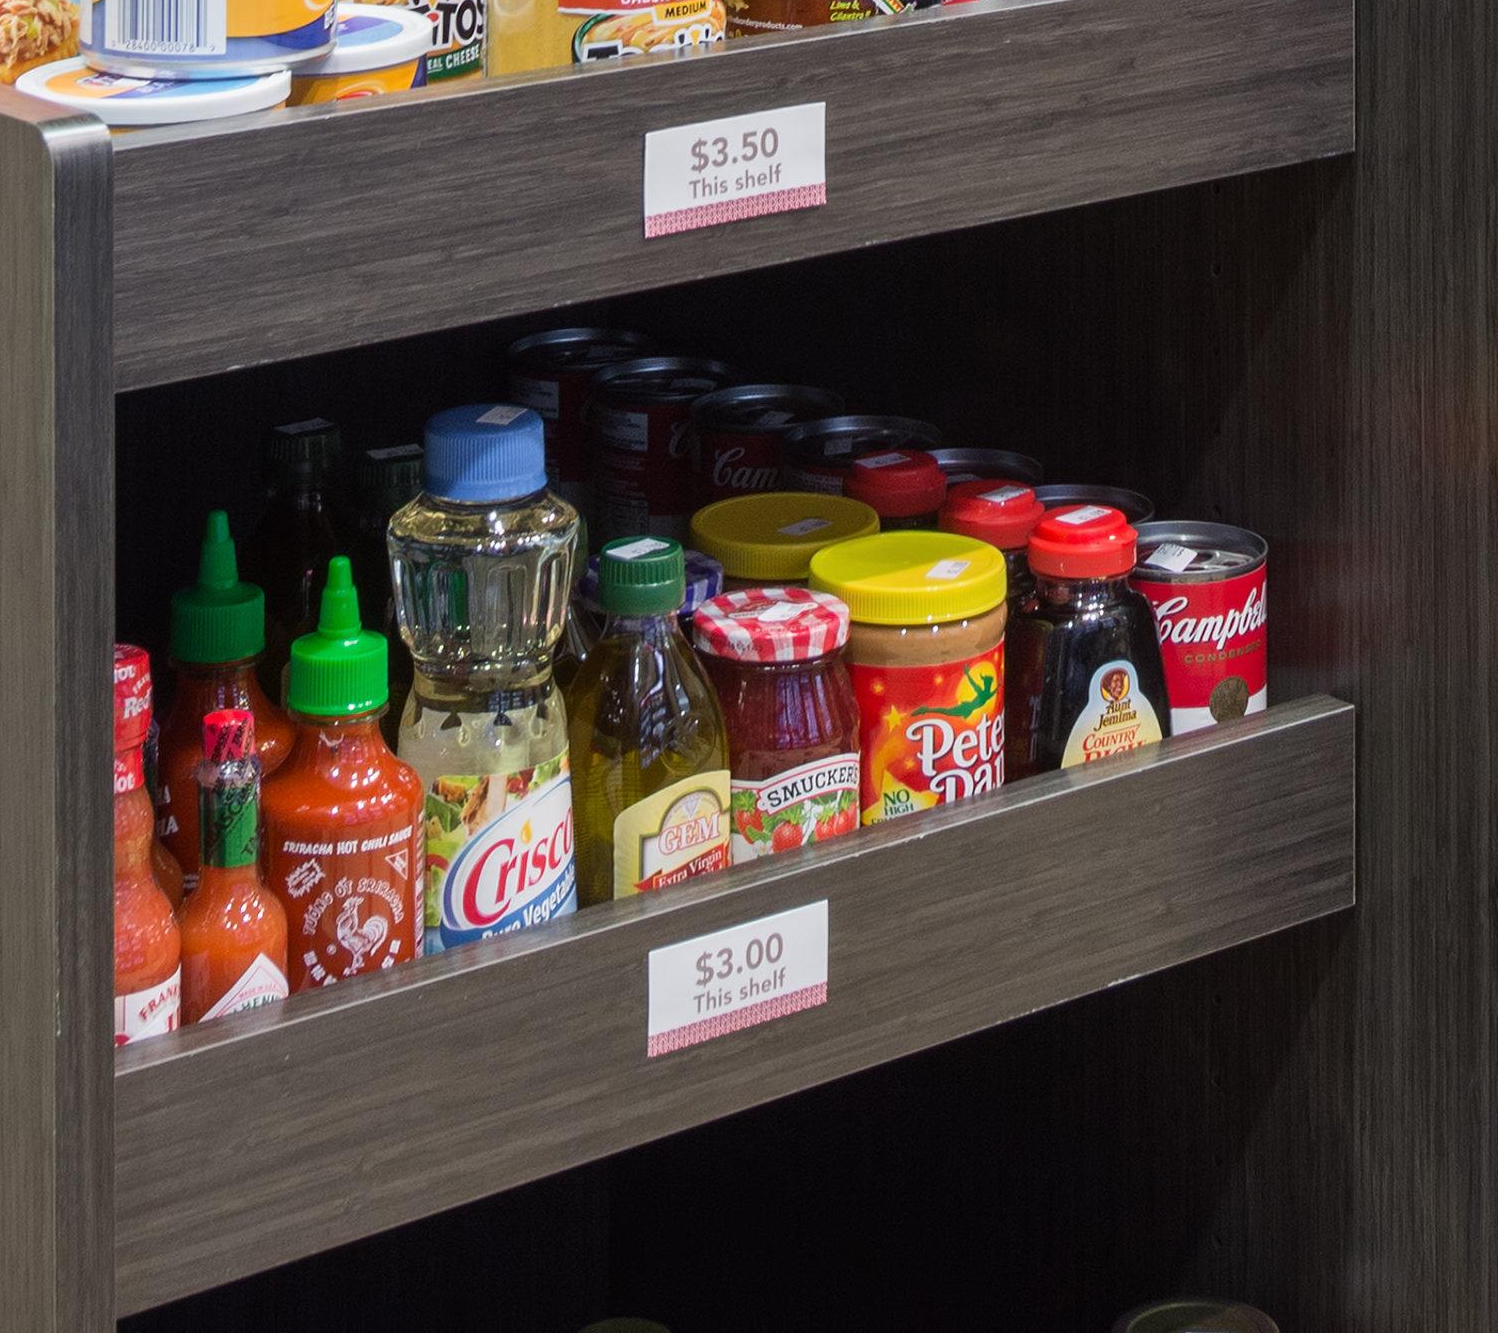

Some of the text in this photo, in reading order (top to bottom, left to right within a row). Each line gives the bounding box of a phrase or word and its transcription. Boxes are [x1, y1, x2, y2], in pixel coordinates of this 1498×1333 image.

[664, 0, 709, 20] MEDIUM
[689, 126, 780, 175] $3.50
[688, 162, 783, 200] This shelf
[1094, 707, 1138, 732] Jemima
[1104, 698, 1133, 716] Aunt
[1082, 724, 1142, 753] COUNTRY
[765, 761, 860, 812] SMUCKER'S
[883, 790, 911, 808] NO
[282, 838, 334, 855] SRIRACHA
[336, 838, 358, 854] HOT
[360, 835, 389, 853] CHILI
[658, 817, 722, 857] GEM
[462, 805, 574, 927] Crisco
[658, 848, 723, 888] Extra Virgin
[694, 932, 785, 989] $3.00
[693, 969, 787, 1016] This shelf
